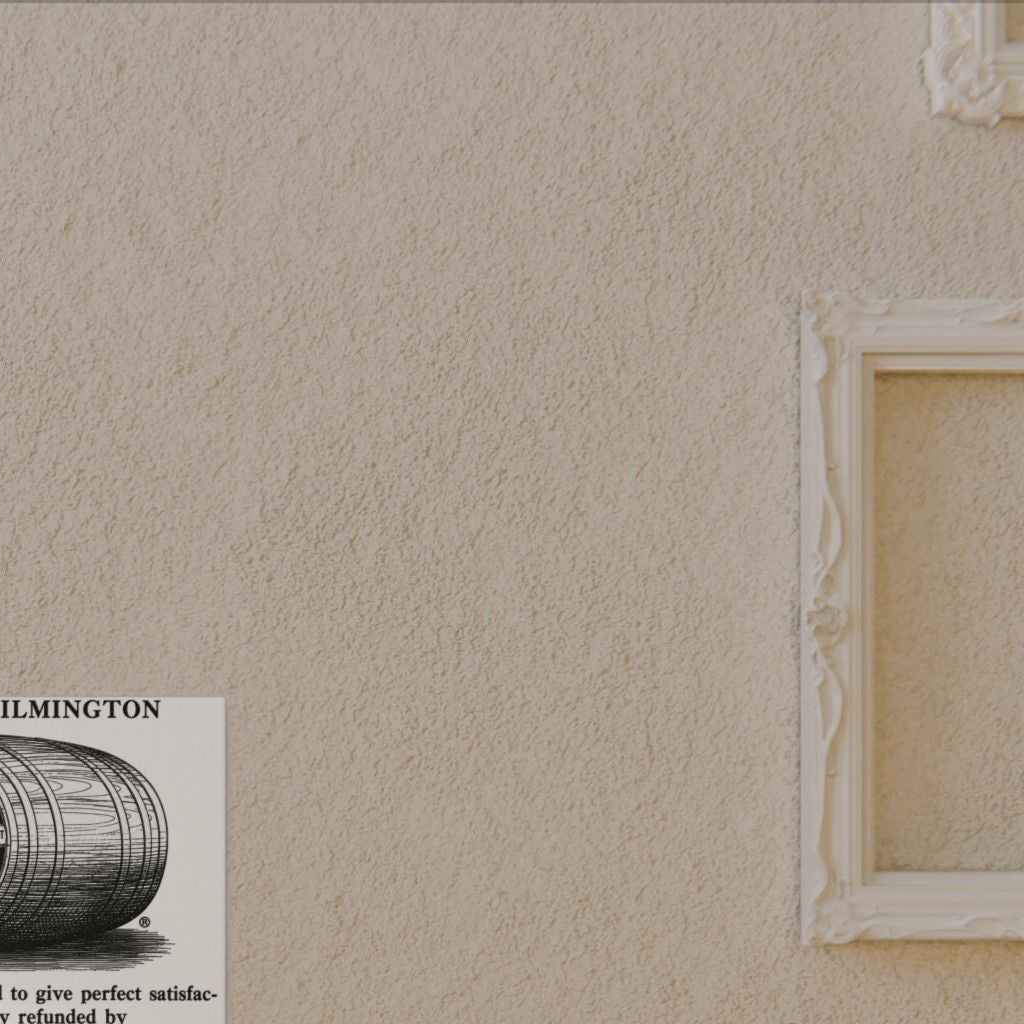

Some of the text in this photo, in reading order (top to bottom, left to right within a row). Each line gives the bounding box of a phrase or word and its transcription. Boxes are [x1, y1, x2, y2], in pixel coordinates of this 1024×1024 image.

[10, 986, 29, 1001] to
[35, 984, 73, 1005] give
[80, 984, 142, 1005] perfect
[149, 984, 218, 1002] satisfac-
[18, 1007, 97, 1024] refunded
